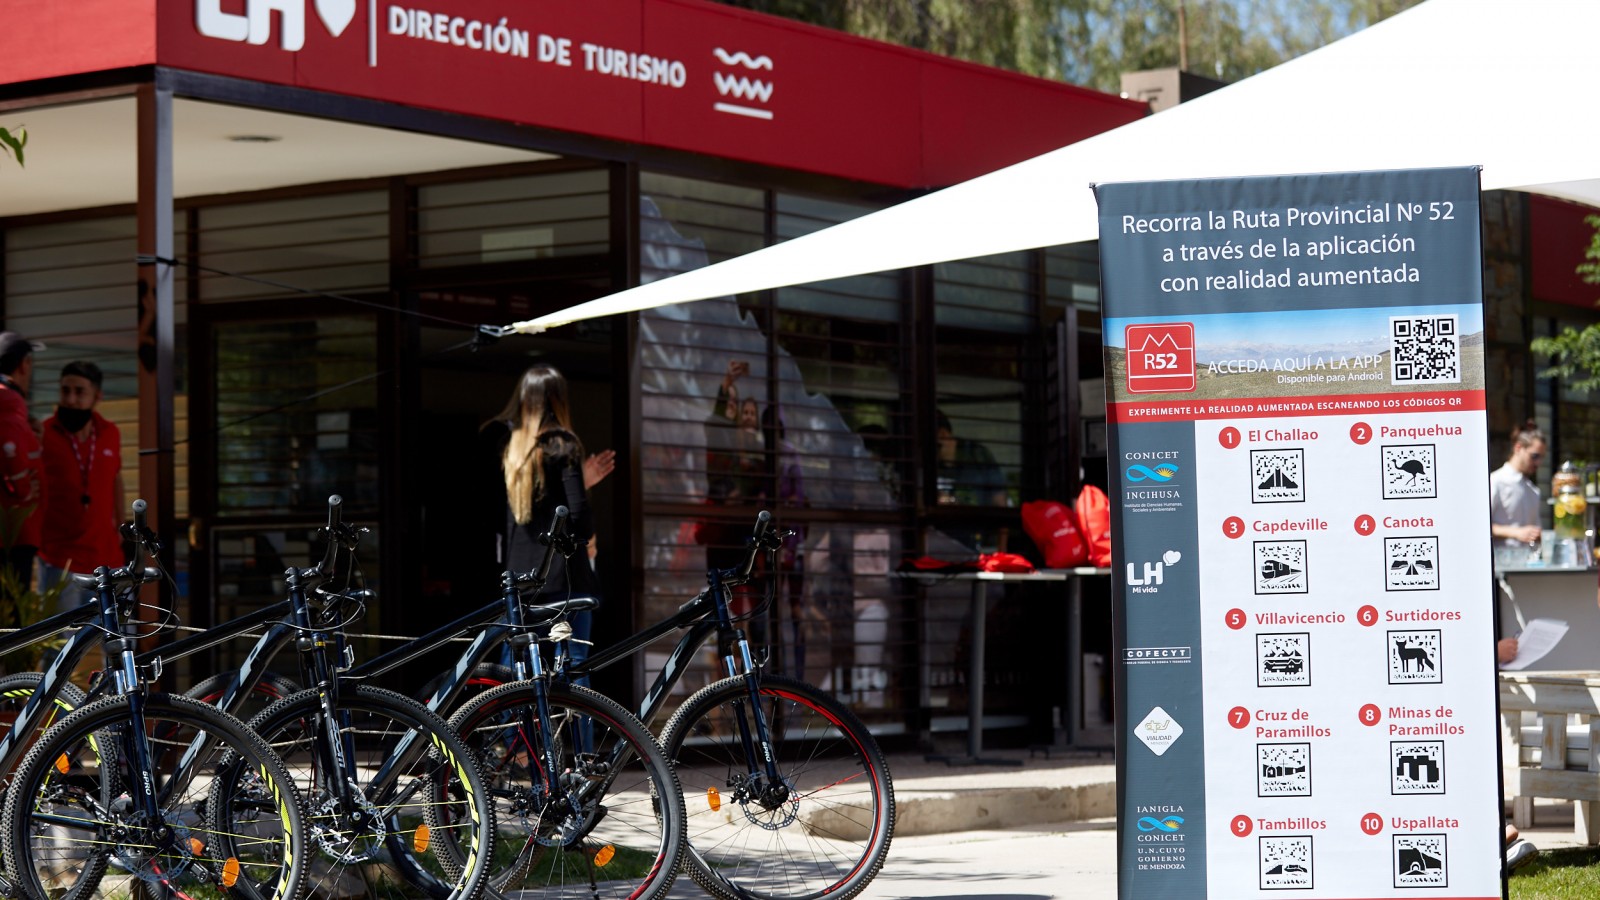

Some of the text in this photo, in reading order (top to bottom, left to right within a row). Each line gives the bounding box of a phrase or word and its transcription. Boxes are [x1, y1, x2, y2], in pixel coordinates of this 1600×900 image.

[388, 5, 687, 88] DIRECCIÓN DE TURISMO
[1123, 202, 1455, 234] Recorra la Ruta Provincial Nº 52
[1163, 234, 1415, 262] a través de la aplicación
[1160, 263, 1419, 292] con realidad aumentada
[1144, 354, 1177, 370] R52
[1208, 355, 1382, 375] ACCEDA AQUÍ A LA APP
[1277, 371, 1383, 385] Disponible para Android
[1129, 397, 1462, 416] EXPERIMENTE LA REALIDAD AUMENTADA ESCANEANDO LOS CÓDIGOS QR
[1226, 428, 1318, 443] 1 El Challao
[1357, 424, 1462, 440] 2 Panquehua
[1125, 451, 1178, 460] CONICET
[1127, 490, 1180, 499] INCIHUSA
[1229, 519, 1328, 535] 3 Capdeville
[1360, 517, 1434, 531] 4 Canota
[1127, 561, 1163, 586] LH
[1231, 612, 1345, 625] 5 Villavicencio
[1362, 609, 1461, 622] 6 Surtidores
[1128, 650, 1186, 658] COFECYT
[1235, 709, 1309, 724] 7 Cruz de
[1365, 706, 1452, 720] 8 Minas de
[1256, 725, 1331, 738] Paramillos
[1389, 722, 1465, 736] Paramillos
[1238, 817, 1326, 832] 9 Tambillos
[1364, 817, 1459, 831] 10 Uspallata
[1138, 834, 1185, 842] CONICET
